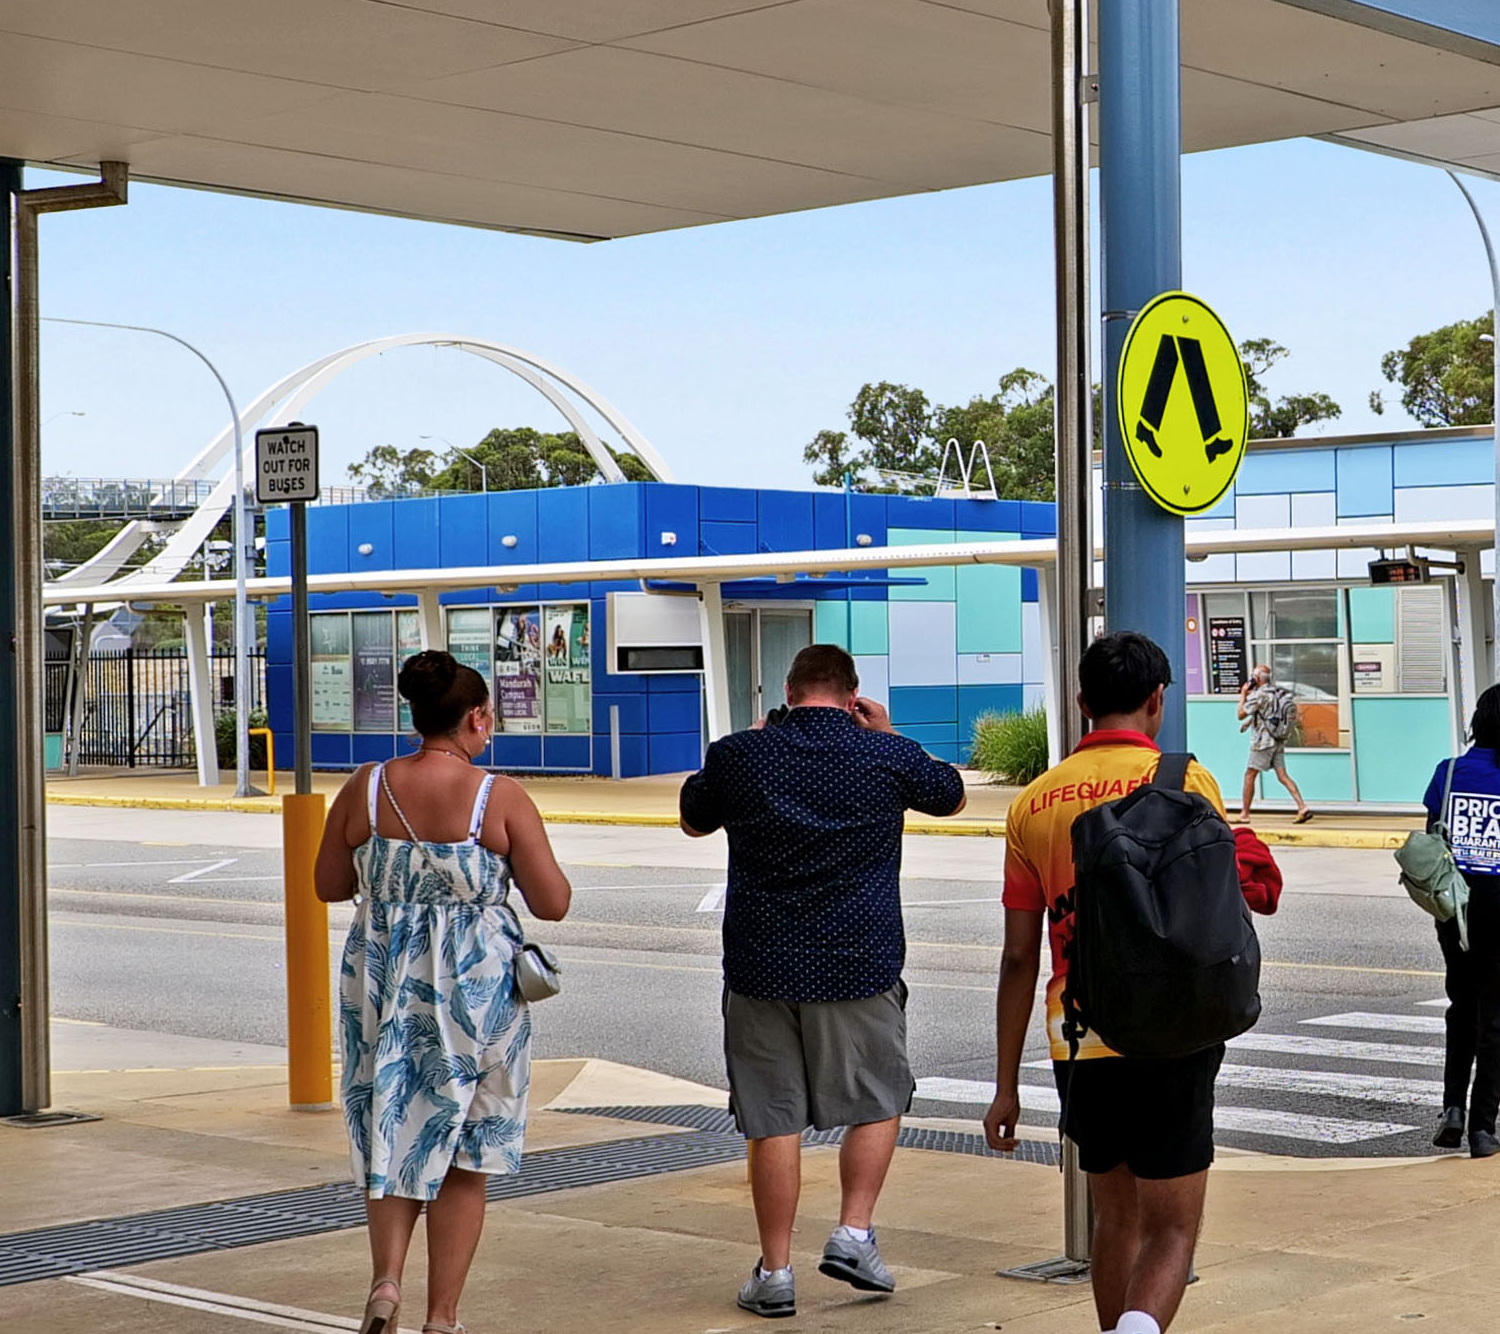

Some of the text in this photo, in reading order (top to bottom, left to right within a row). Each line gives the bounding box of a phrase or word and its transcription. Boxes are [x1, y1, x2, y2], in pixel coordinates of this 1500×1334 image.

[268, 440, 305, 455] WATCH
[263, 458, 310, 473] OUT FOR
[269, 477, 305, 492] BUSES
